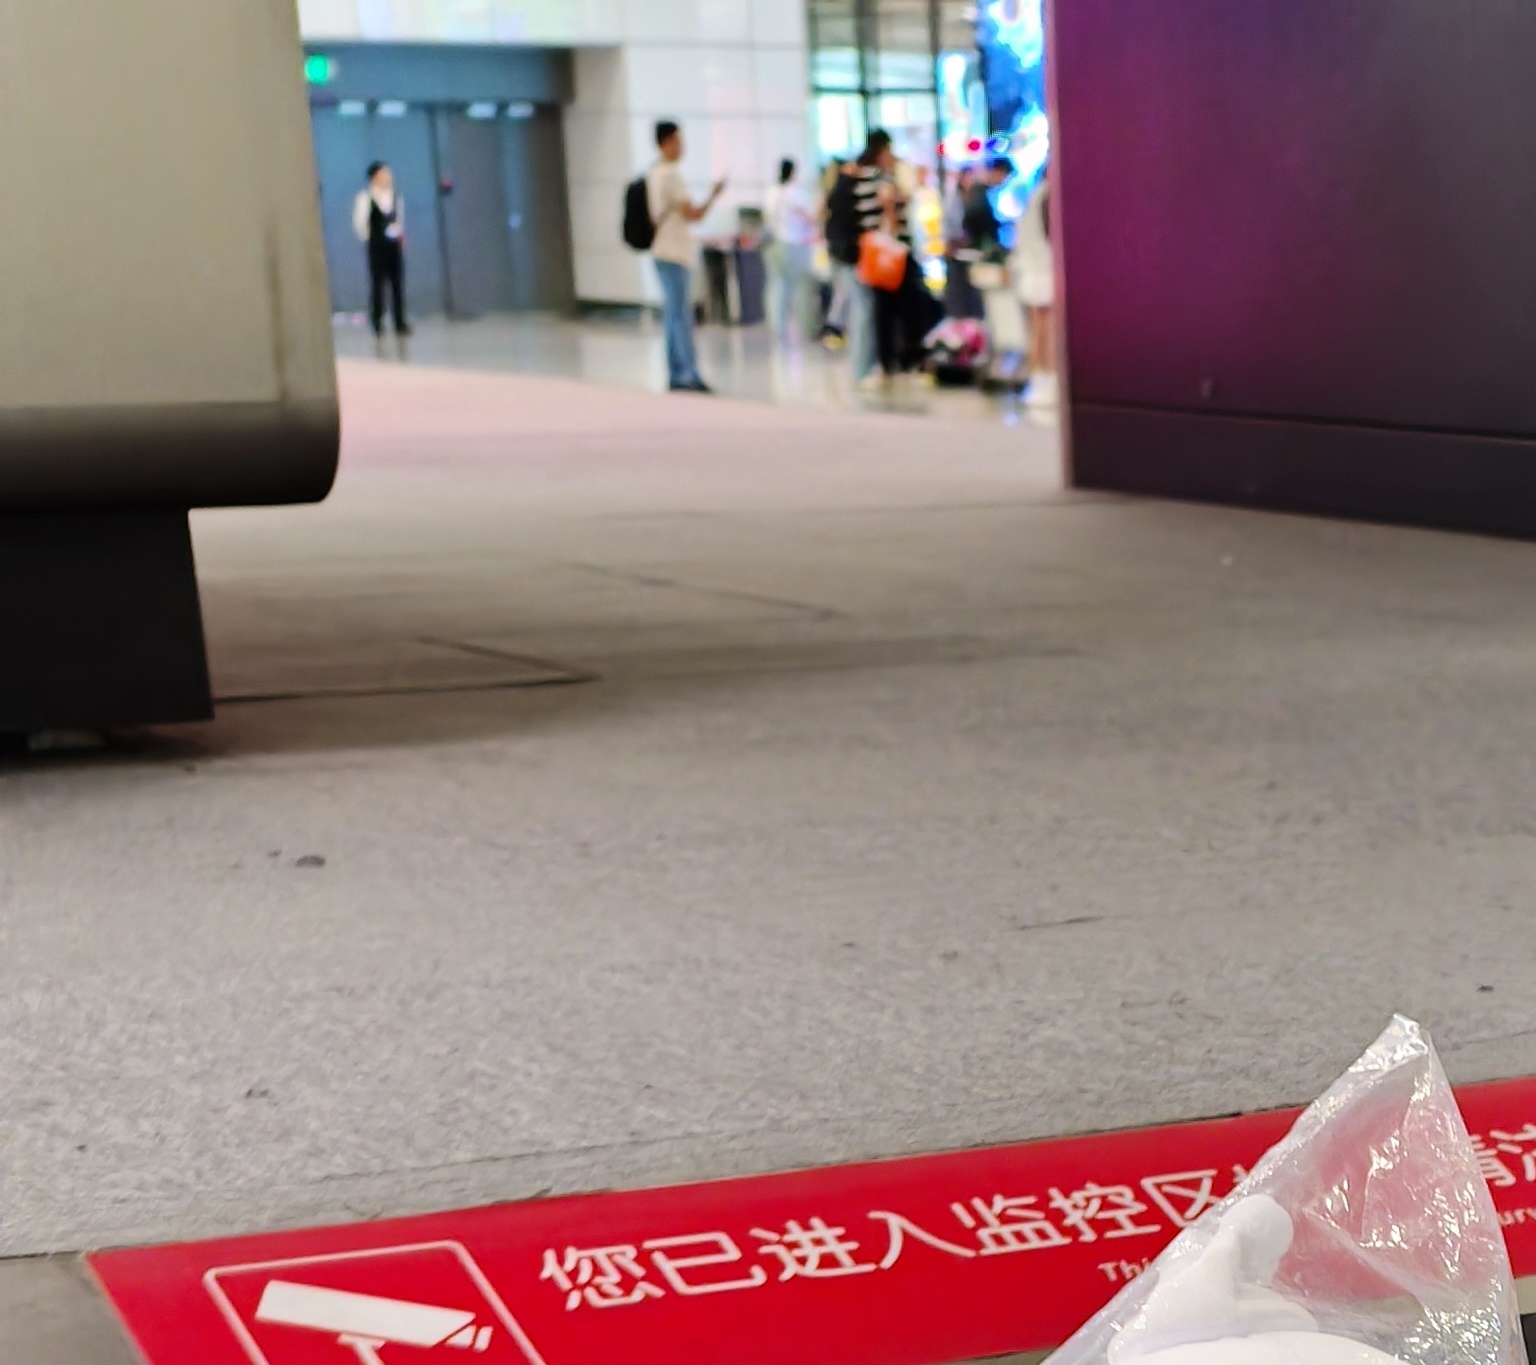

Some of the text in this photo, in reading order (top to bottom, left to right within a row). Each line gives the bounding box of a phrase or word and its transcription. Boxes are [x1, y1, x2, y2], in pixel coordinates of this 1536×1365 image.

[538, 1164, 1250, 1309] 您已进入监控区
